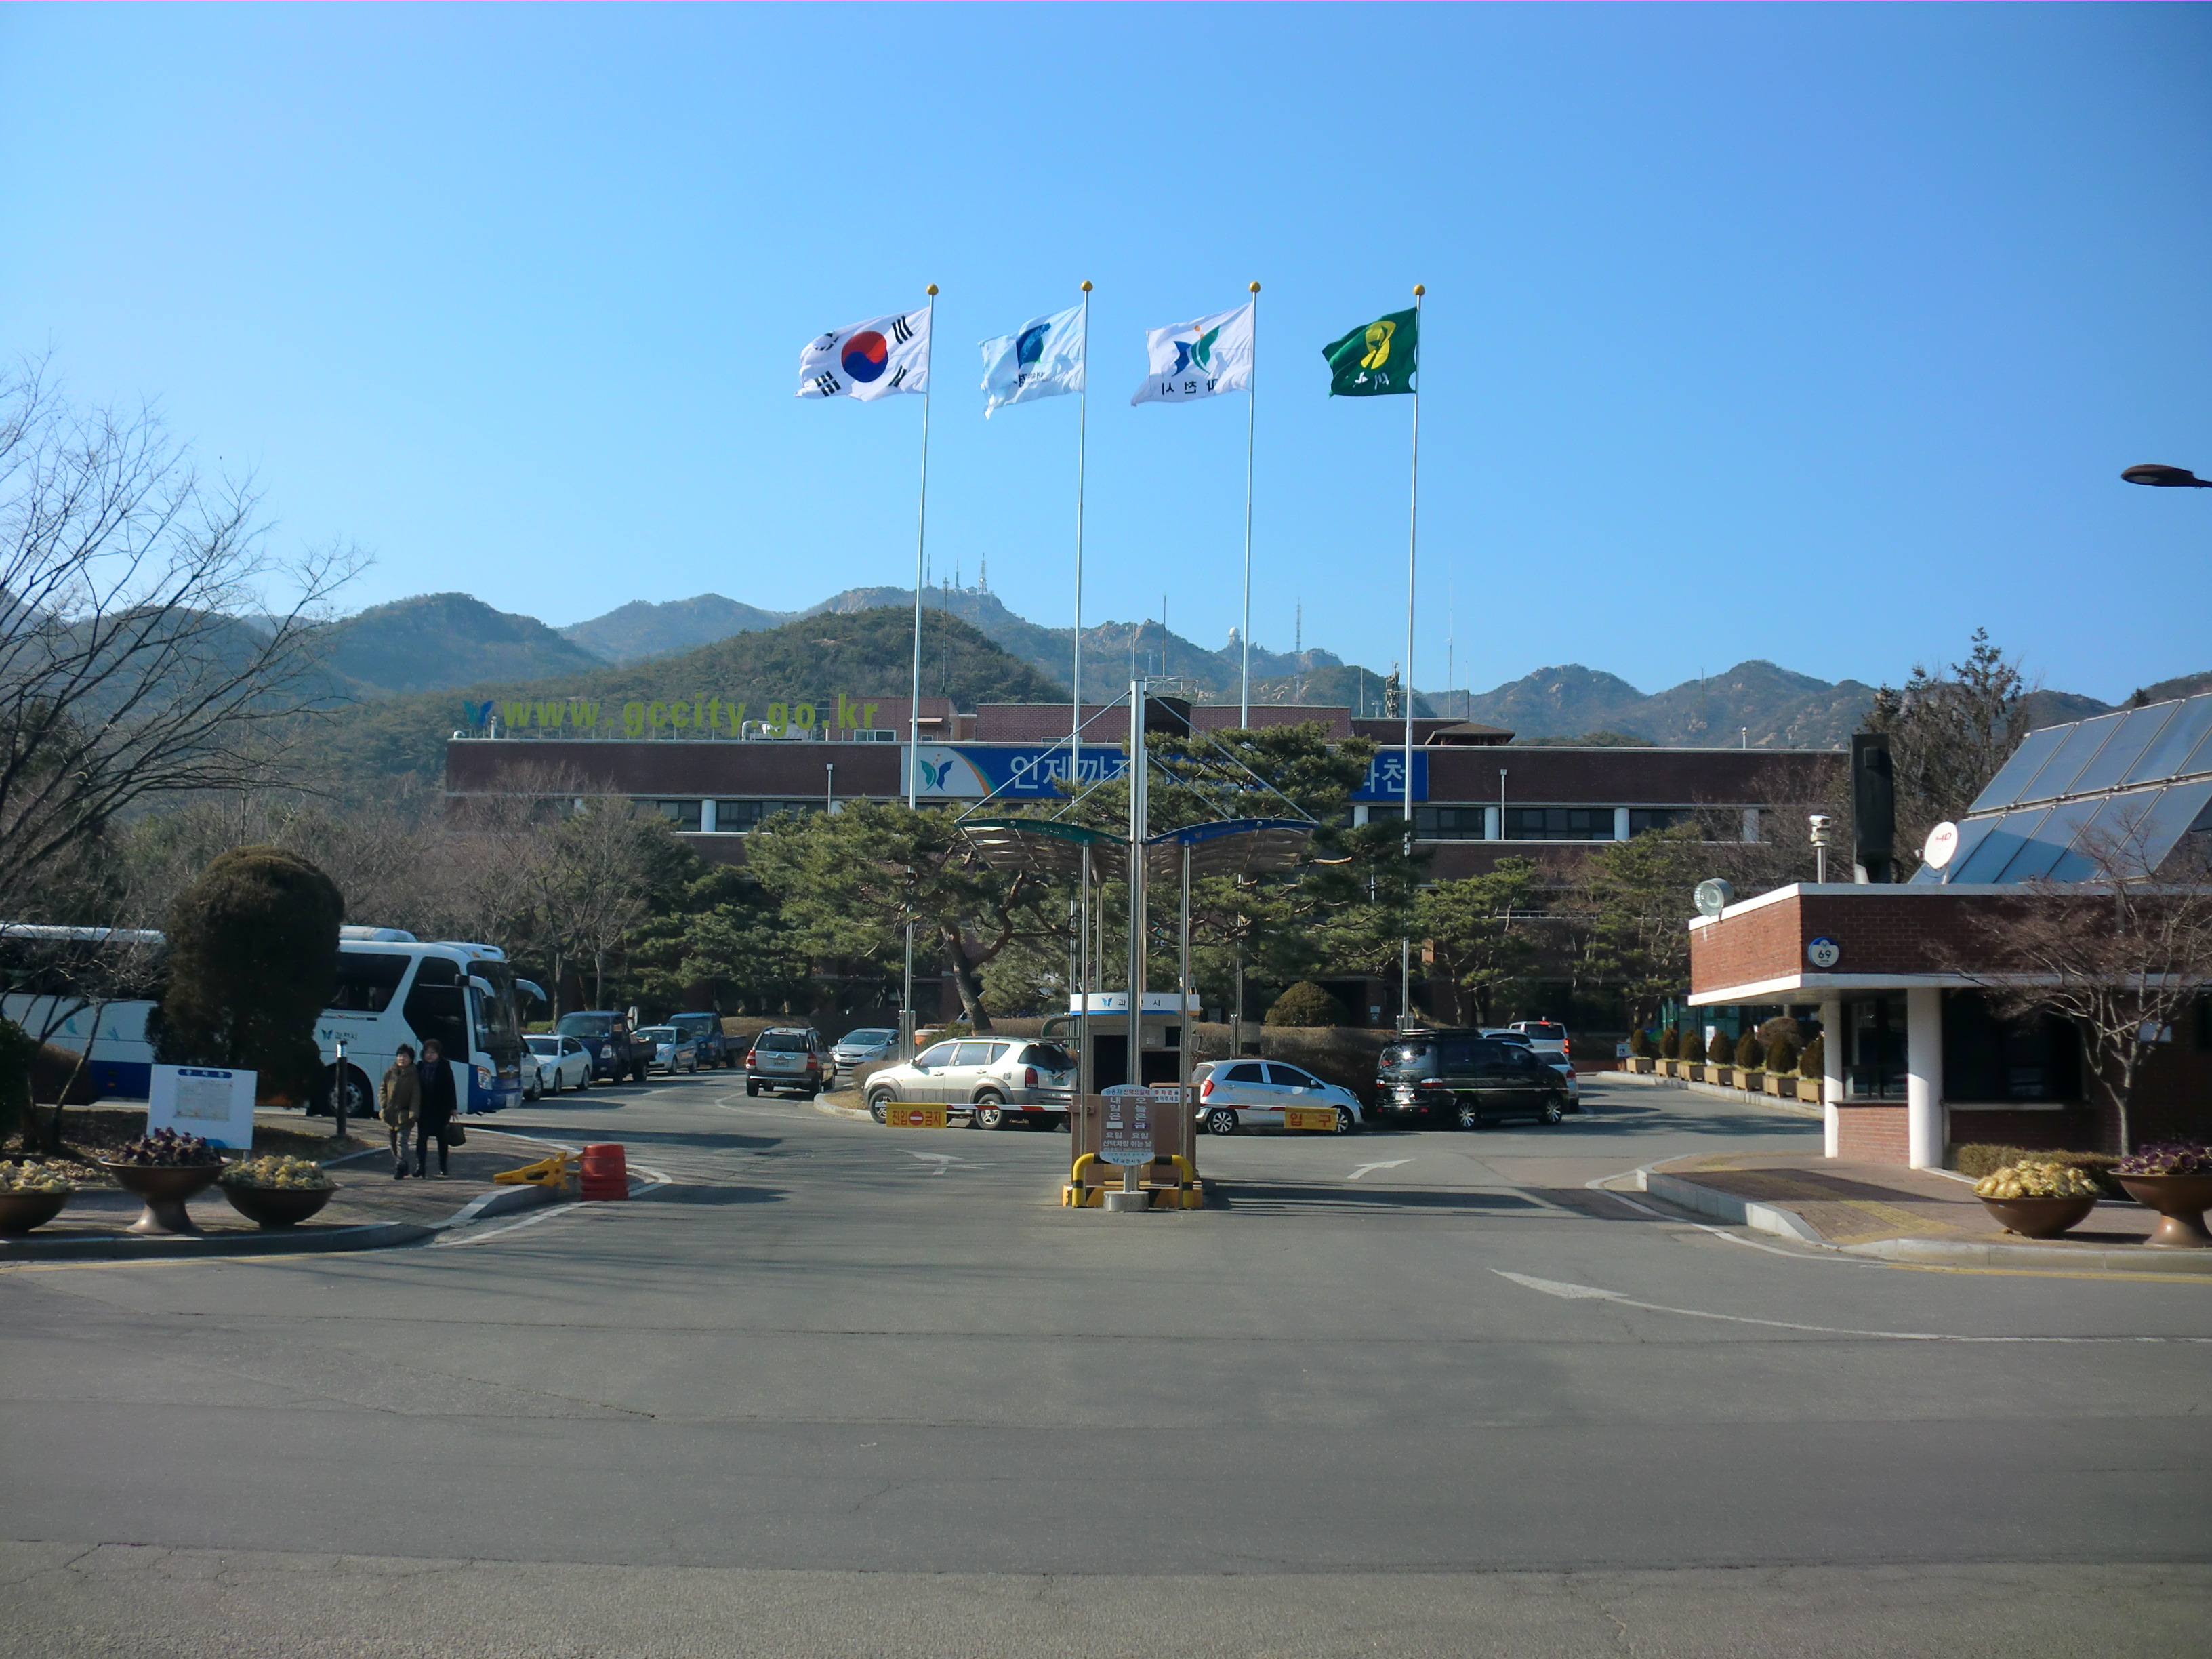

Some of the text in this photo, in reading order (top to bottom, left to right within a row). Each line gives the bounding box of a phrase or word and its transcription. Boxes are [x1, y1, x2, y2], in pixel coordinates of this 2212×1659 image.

[502, 693, 878, 737] www.gccity.go.kr
[1936, 832, 1952, 842] HD
[1818, 950, 1831, 959] 69
[1118, 999, 1161, 1007] 과시
[1109, 1097, 1121, 1120] 내일은
[1135, 1097, 1147, 1121] 오늘은
[892, 1110, 941, 1126] 진입 금지
[1290, 1113, 1331, 1128] 입구
